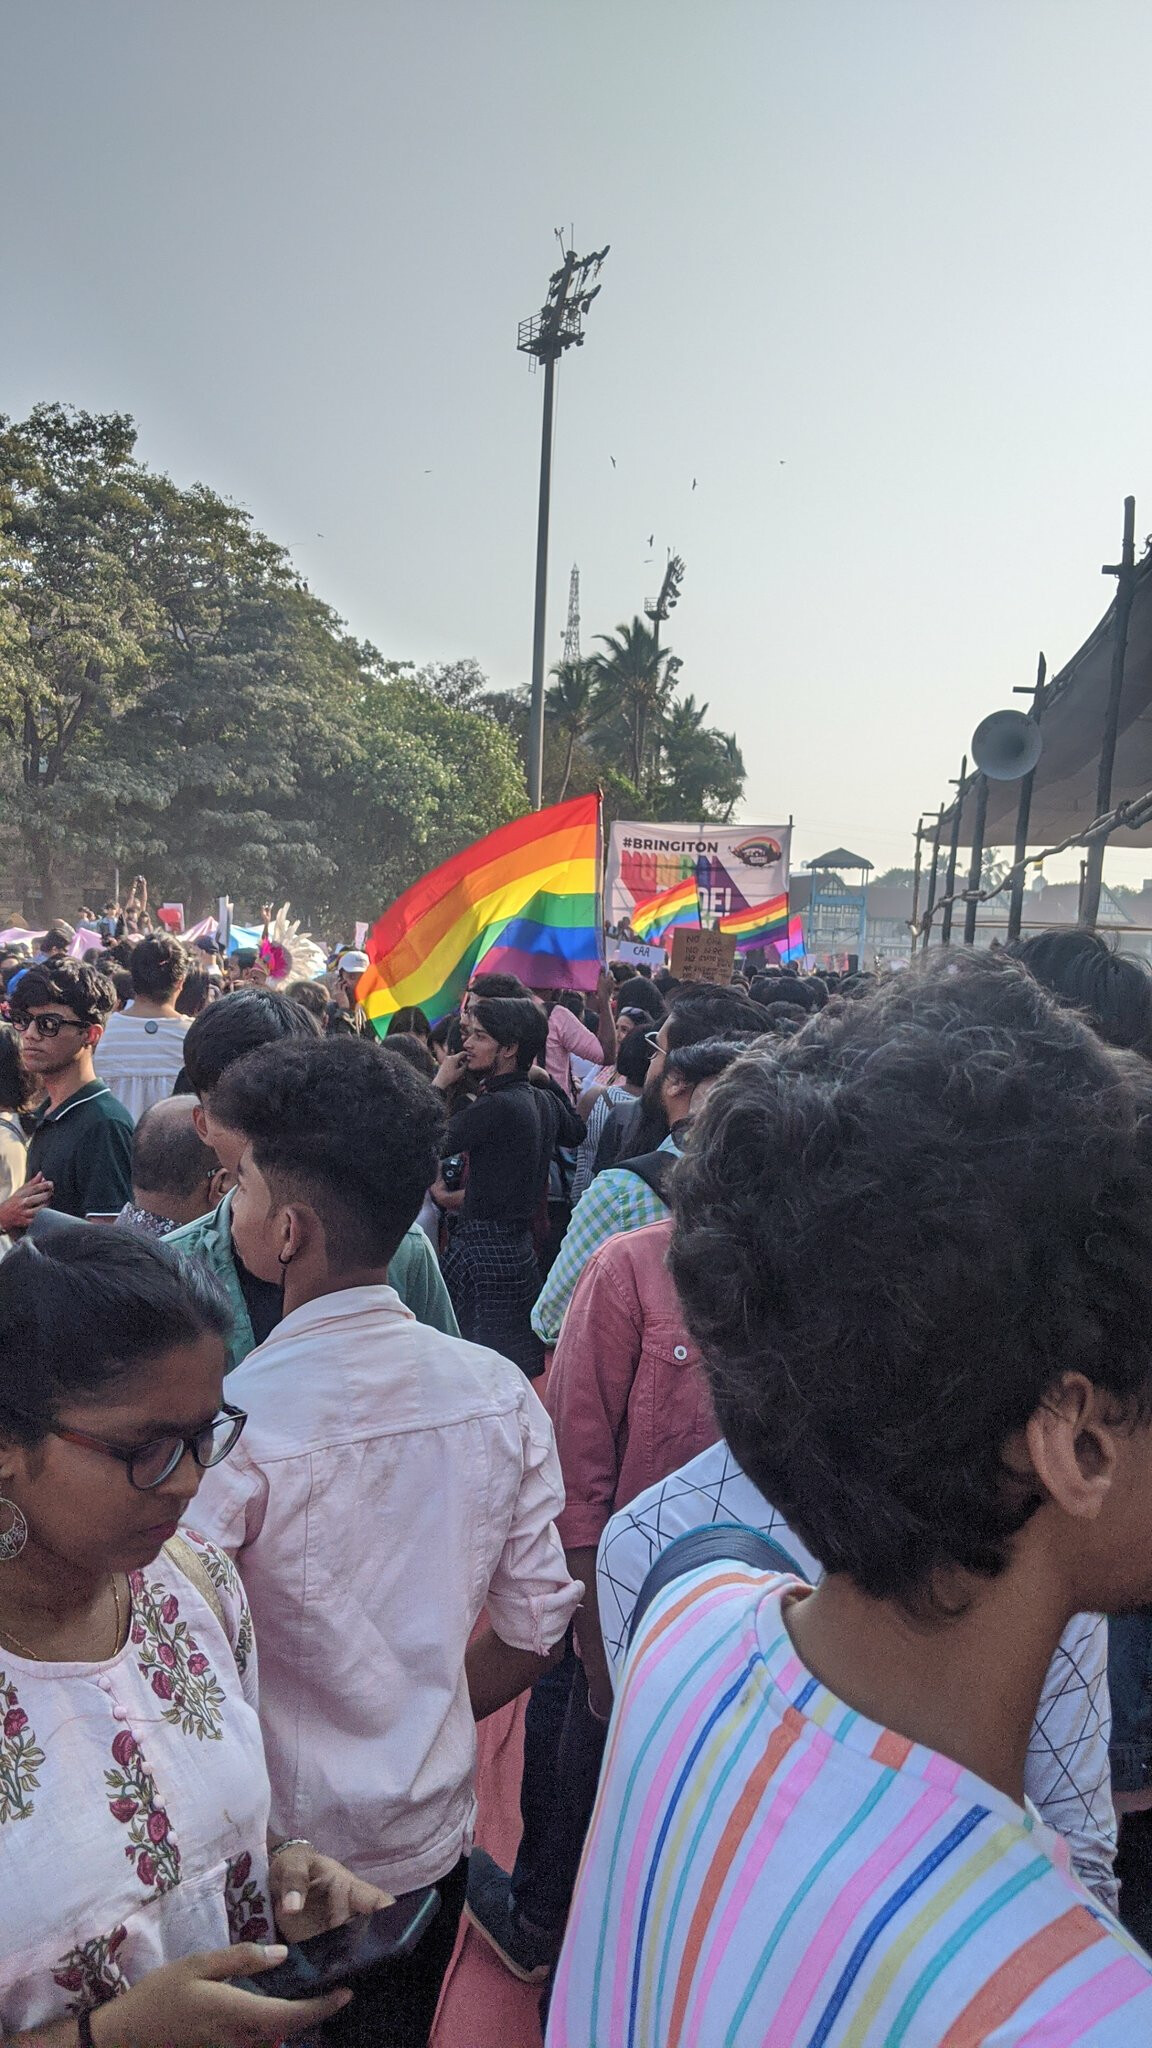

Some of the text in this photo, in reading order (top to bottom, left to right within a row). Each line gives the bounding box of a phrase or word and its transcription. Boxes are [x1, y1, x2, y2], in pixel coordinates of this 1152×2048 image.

[622, 837, 718, 853] #BRINGITON
[686, 935, 700, 943] NO
[633, 946, 650, 957] CAA
[685, 946, 699, 954] NO
